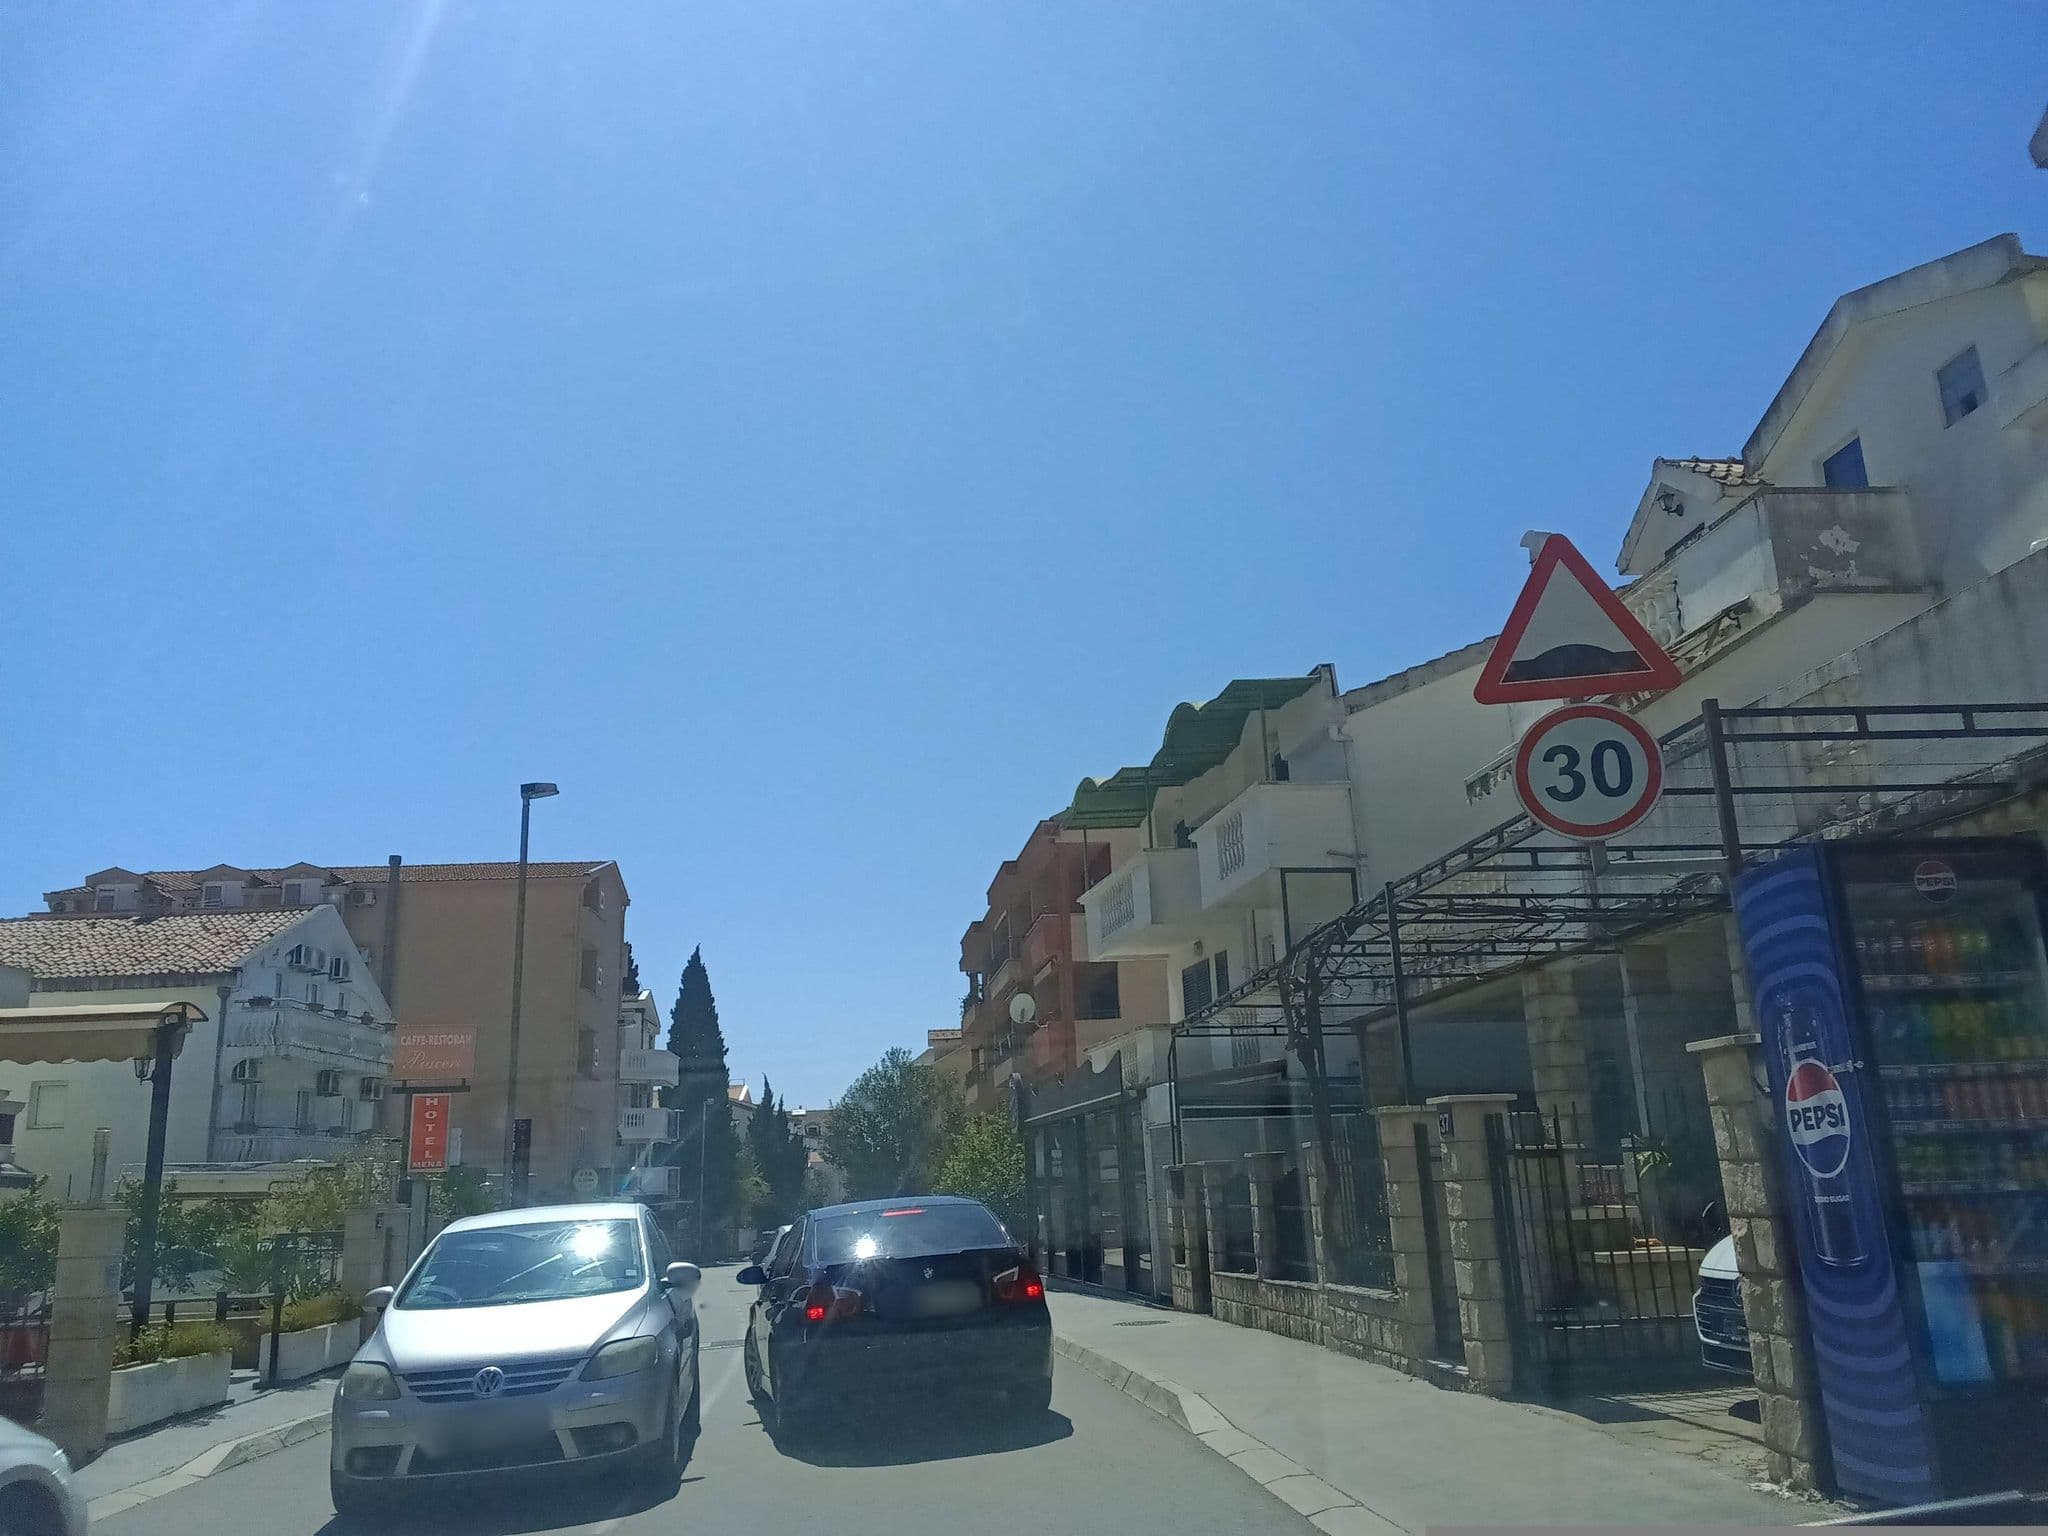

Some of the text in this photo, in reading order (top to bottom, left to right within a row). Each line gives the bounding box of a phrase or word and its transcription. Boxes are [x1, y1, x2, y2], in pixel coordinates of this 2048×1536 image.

[1543, 740, 1633, 802] 30
[1917, 877, 1953, 889] PEPSI
[424, 1097, 439, 1159] HOTEL
[1790, 1103, 1845, 1133] PEPSI
[411, 1161, 443, 1169] MENA
